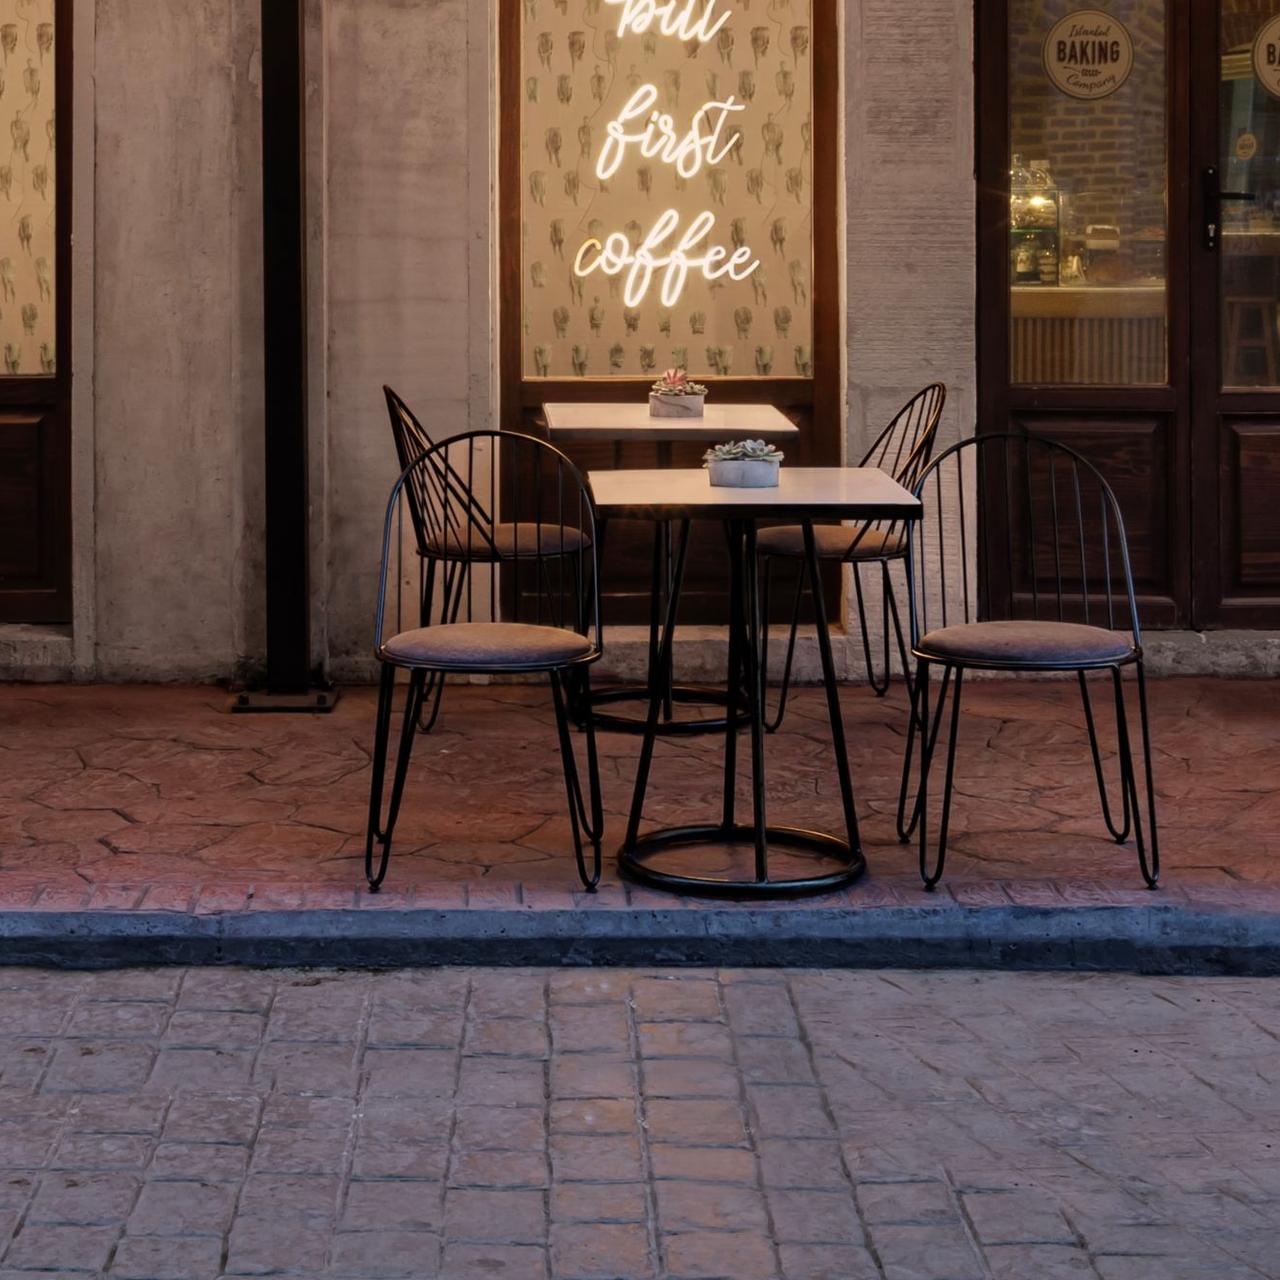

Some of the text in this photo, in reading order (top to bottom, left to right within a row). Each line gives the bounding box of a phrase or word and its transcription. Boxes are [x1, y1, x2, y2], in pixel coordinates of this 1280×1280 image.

[1069, 24, 1111, 37] Istanbul
[1057, 40, 1120, 65] BAKING
[1067, 74, 1117, 92] Company
[595, 83, 745, 180] first
[574, 209, 760, 308] coffee
